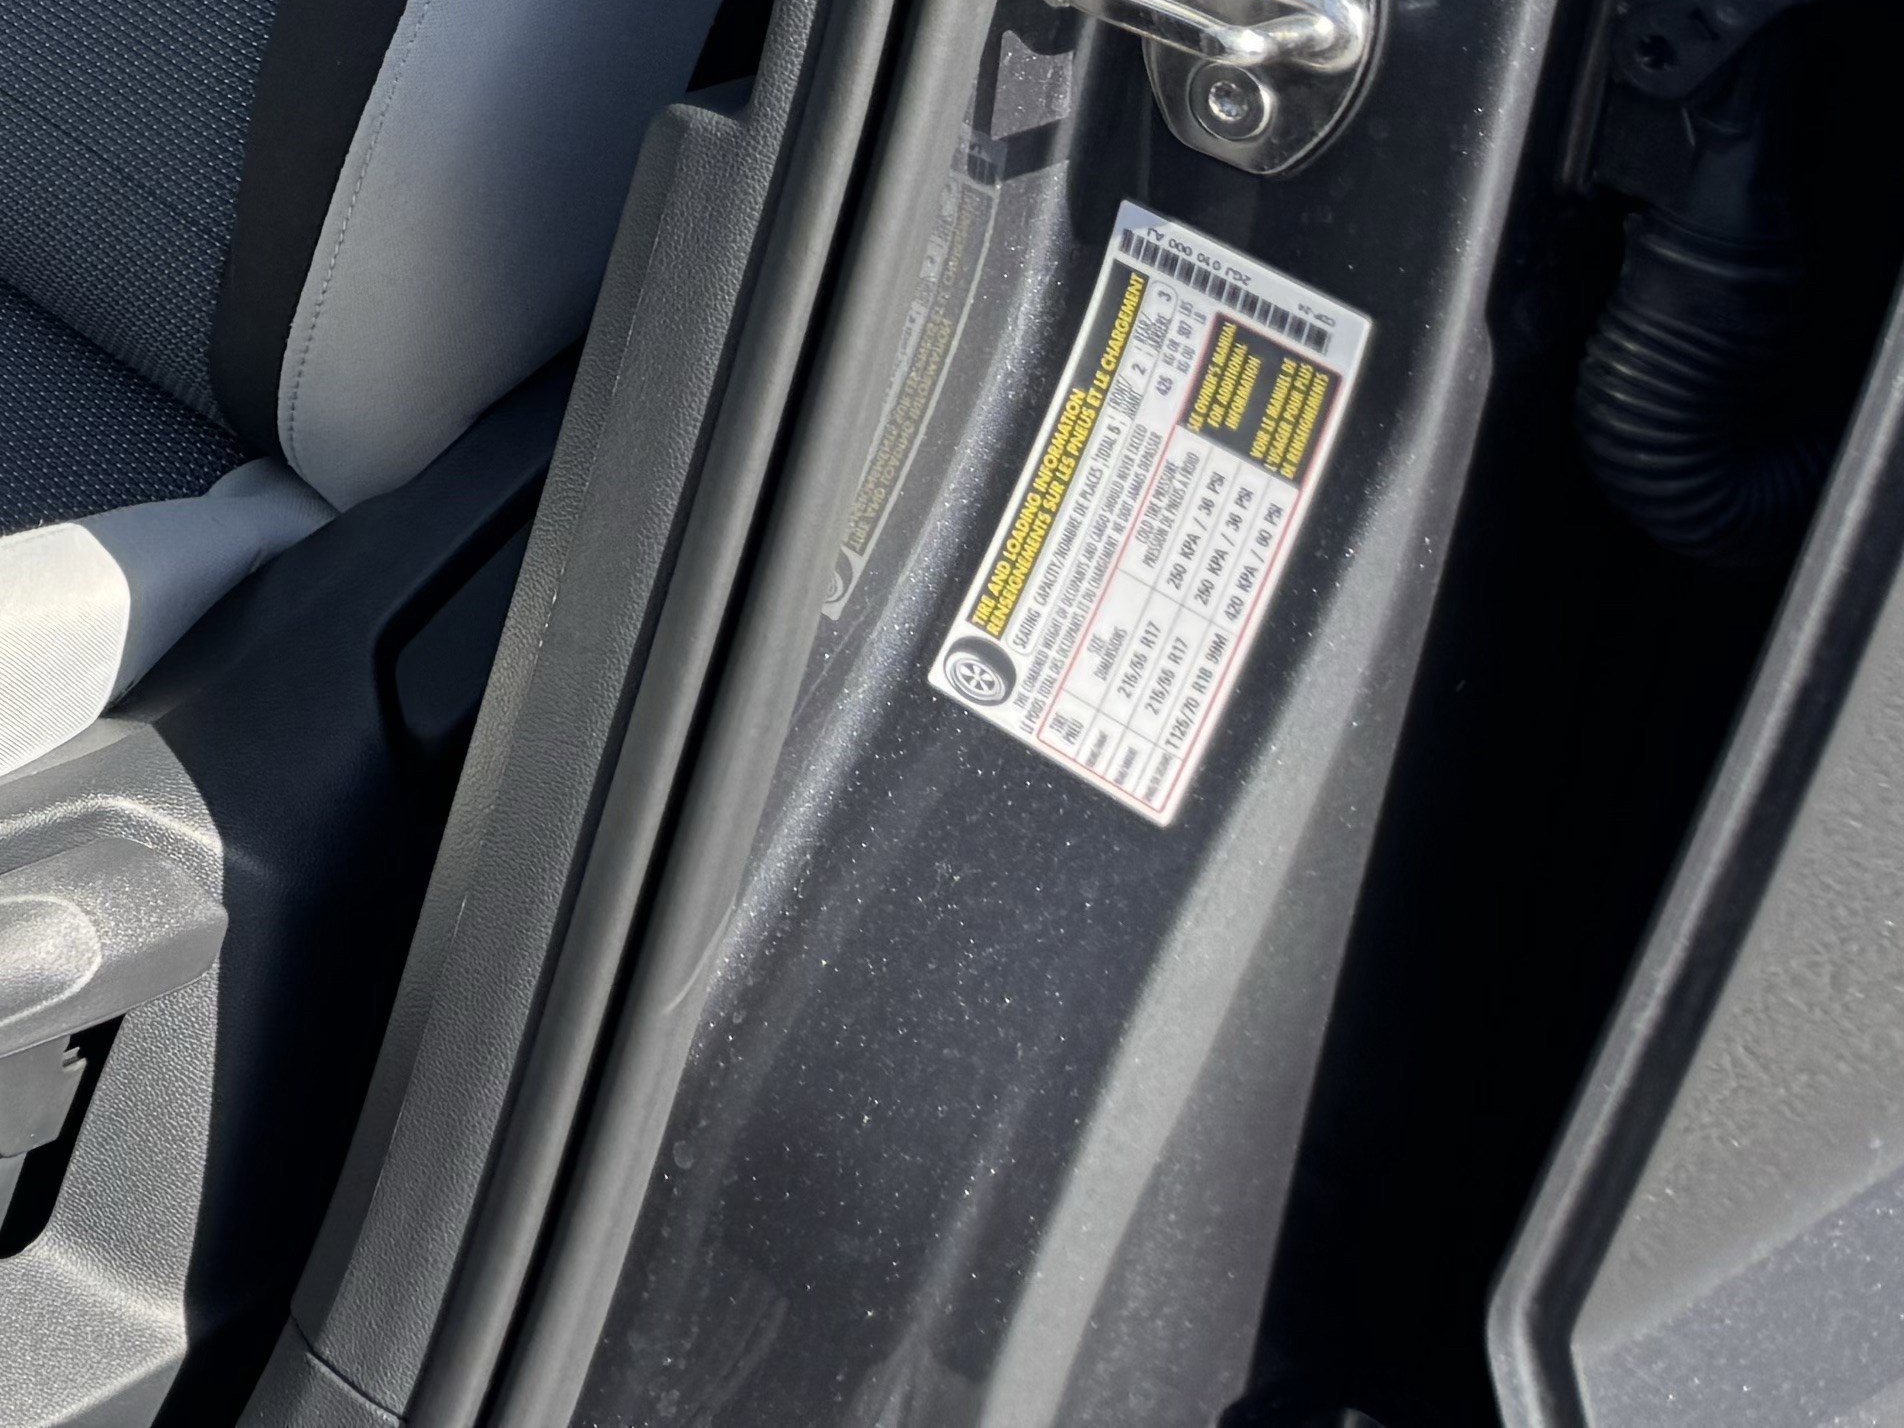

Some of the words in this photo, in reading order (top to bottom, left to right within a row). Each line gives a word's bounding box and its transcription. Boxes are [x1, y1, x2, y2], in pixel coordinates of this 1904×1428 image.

[1144, 226, 1165, 243] AJ
[1166, 237, 1195, 258] 000
[1195, 251, 1223, 271] 010
[1223, 266, 1251, 286] 2GJ
[1157, 289, 1172, 302] 3
[1099, 271, 1144, 372] CHARGEMENT
[1211, 321, 1237, 366] MANUAL
[1093, 369, 1110, 389] LE
[1130, 361, 1146, 375] 2
[1215, 341, 1248, 405] ADDITIONAL
[1085, 387, 1102, 407] ET
[1225, 354, 1262, 430] INFORMATION
[1265, 373, 1292, 419] MANUEL
[1282, 389, 1304, 422] POUR
[1294, 362, 1313, 390] PLUS
[1065, 406, 1096, 456] PNEUS
[1207, 402, 1226, 428] FOR
[1055, 455, 1076, 481] LES
[1095, 434, 1117, 462] TOTAL
[1041, 479, 1065, 512] SUR
[1079, 465, 1104, 502] PLACES
[971, 594, 996, 625] TIRE
[988, 559, 1012, 596] AND
[1003, 490, 1043, 561] LOADING
[1032, 387, 1086, 492] INFORMATION
[1072, 500, 1088, 517] DE
[1178, 532, 1201, 561] KPA
[1206, 470, 1225, 494] PSI
[1205, 548, 1229, 577] KPA
[1233, 485, 1254, 510] PSI
[986, 510, 1052, 635] RENSEIGNEMENTS
[1032, 514, 1082, 606] CAPACITY/NOMBRE
[1223, 593, 1245, 623] 420
[1235, 565, 1258, 593] KPA
[1263, 501, 1283, 526] PSI
[1012, 606, 1041, 649] SEATING
